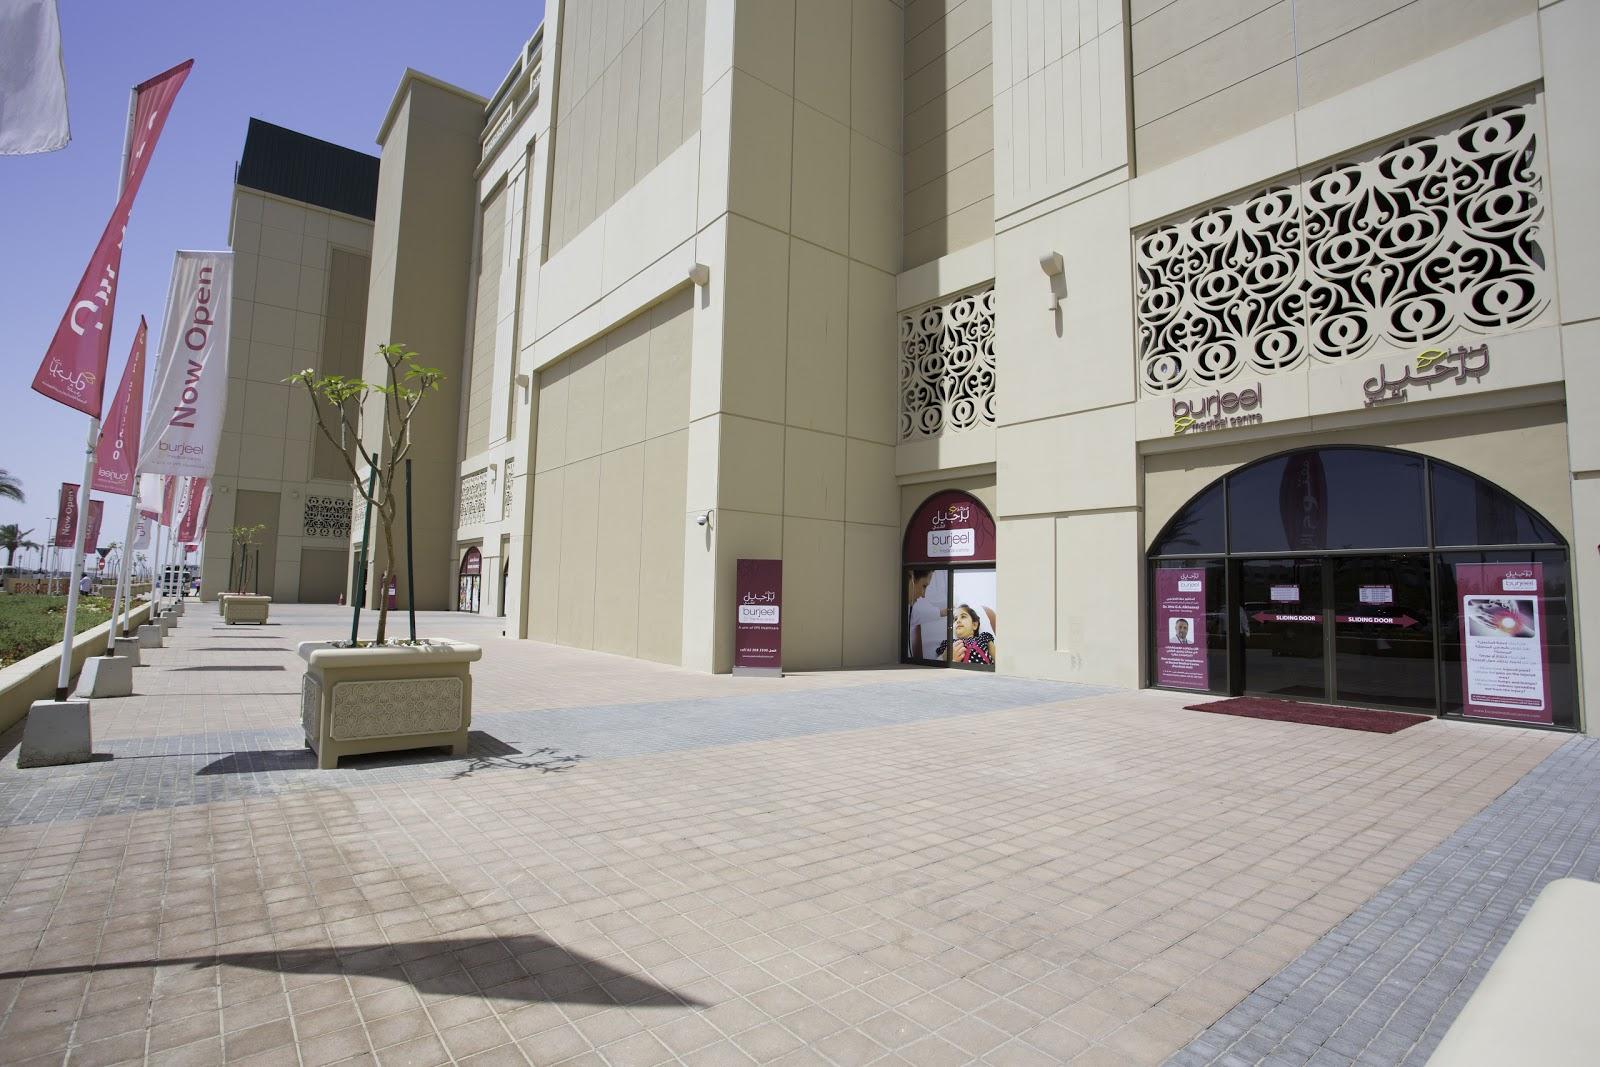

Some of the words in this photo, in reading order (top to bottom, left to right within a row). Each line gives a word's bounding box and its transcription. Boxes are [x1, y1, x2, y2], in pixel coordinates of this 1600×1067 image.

[185, 267, 214, 351] Open
[1364, 347, 1489, 398] برجيل
[169, 359, 203, 428] Now
[1172, 382, 1262, 419] burjeel
[1192, 416, 1228, 433] medical
[159, 440, 204, 456] burjeel
[62, 516, 71, 535] Now
[932, 510, 970, 525] برجيل
[932, 531, 970, 548] burjeel
[743, 607, 776, 618] burjeel
